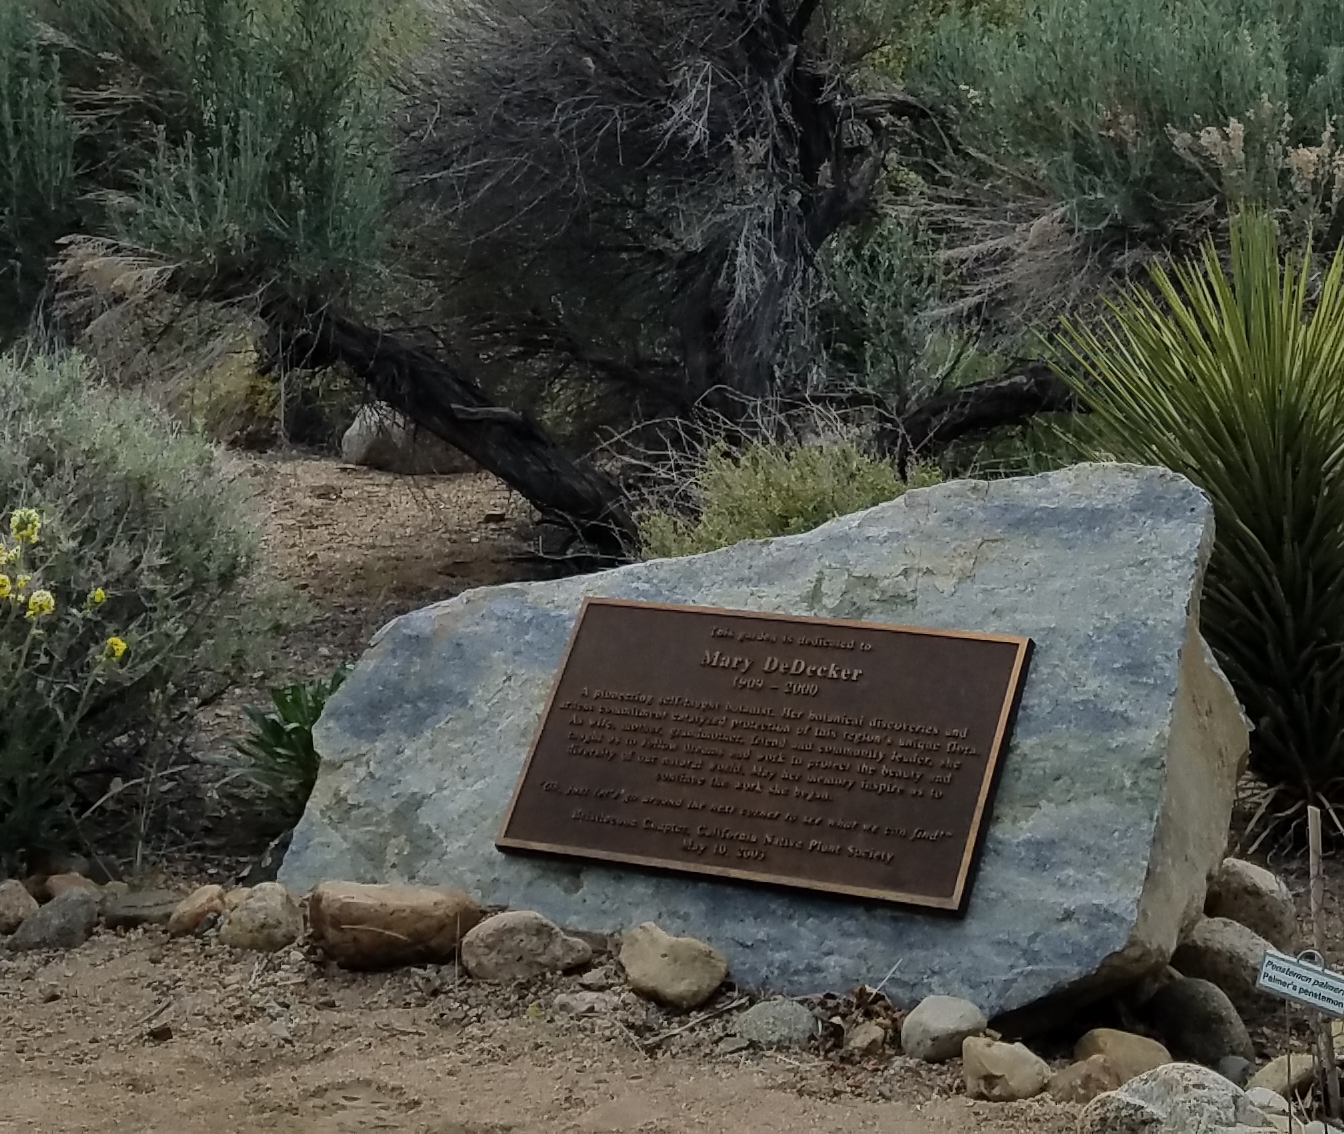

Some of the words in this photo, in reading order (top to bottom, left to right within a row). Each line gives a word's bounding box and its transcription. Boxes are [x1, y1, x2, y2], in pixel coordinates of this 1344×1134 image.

[710, 626, 735, 638] This
[738, 629, 777, 644] garden
[782, 634, 794, 644] is
[797, 635, 854, 650] dedicated
[859, 641, 872, 651] to
[700, 649, 754, 673] Mary
[763, 655, 864, 681] DeDecker
[733, 675, 763, 689] 1909
[783, 681, 819, 696] 2000
[581, 687, 590, 696] A
[593, 688, 654, 705] pioneering
[658, 695, 720, 712] self-taught
[781, 708, 803, 719] Her
[807, 710, 863, 726] botanical
[868, 718, 940, 735] discoveries
[945, 726, 968, 738] and
[672, 710, 726, 728] catalyzed
[730, 719, 790, 735] protection
[796, 724, 811, 736] of
[814, 727, 837, 739] this
[843, 729, 892, 747] region's
[897, 737, 940, 753] unique
[946, 741, 981, 756] flora.
[625, 737, 638, 746] to
[730, 747, 751, 759] and
[756, 749, 786, 763] work
[790, 755, 804, 765] to
[806, 758, 850, 774] protect
[857, 762, 876, 774] the
[880, 765, 923, 783] beauty
[929, 770, 951, 784] and
[751, 734, 786, 748] friend
[791, 740, 813, 751] and
[818, 742, 884, 761] community
[890, 750, 934, 766] leader,
[940, 757, 962, 769] she
[620, 750, 635, 761] of
[750, 765, 777, 780] May
[781, 769, 802, 781] her
[806, 774, 855, 790] memory
[860, 779, 903, 796] inspire
[909, 787, 924, 797] us
[930, 788, 945, 798] to
[710, 775, 730, 788] the
[735, 778, 763, 792] work
[769, 783, 790, 795] she
[793, 785, 834, 803] began.
[687, 799, 706, 810] the
[784, 812, 798, 822] to
[802, 814, 822, 825] see
[827, 816, 858, 829] what
[862, 822, 879, 832] we
[681, 838, 708, 856] May
[697, 825, 759, 843] California
[764, 834, 804, 849] Native
[809, 840, 842, 855] Plant
[846, 845, 895, 864] Society
[1265, 960, 1312, 984] Penstemon
[1262, 971, 1298, 991] Palmer's
[1298, 986, 1344, 1008] penstemon
